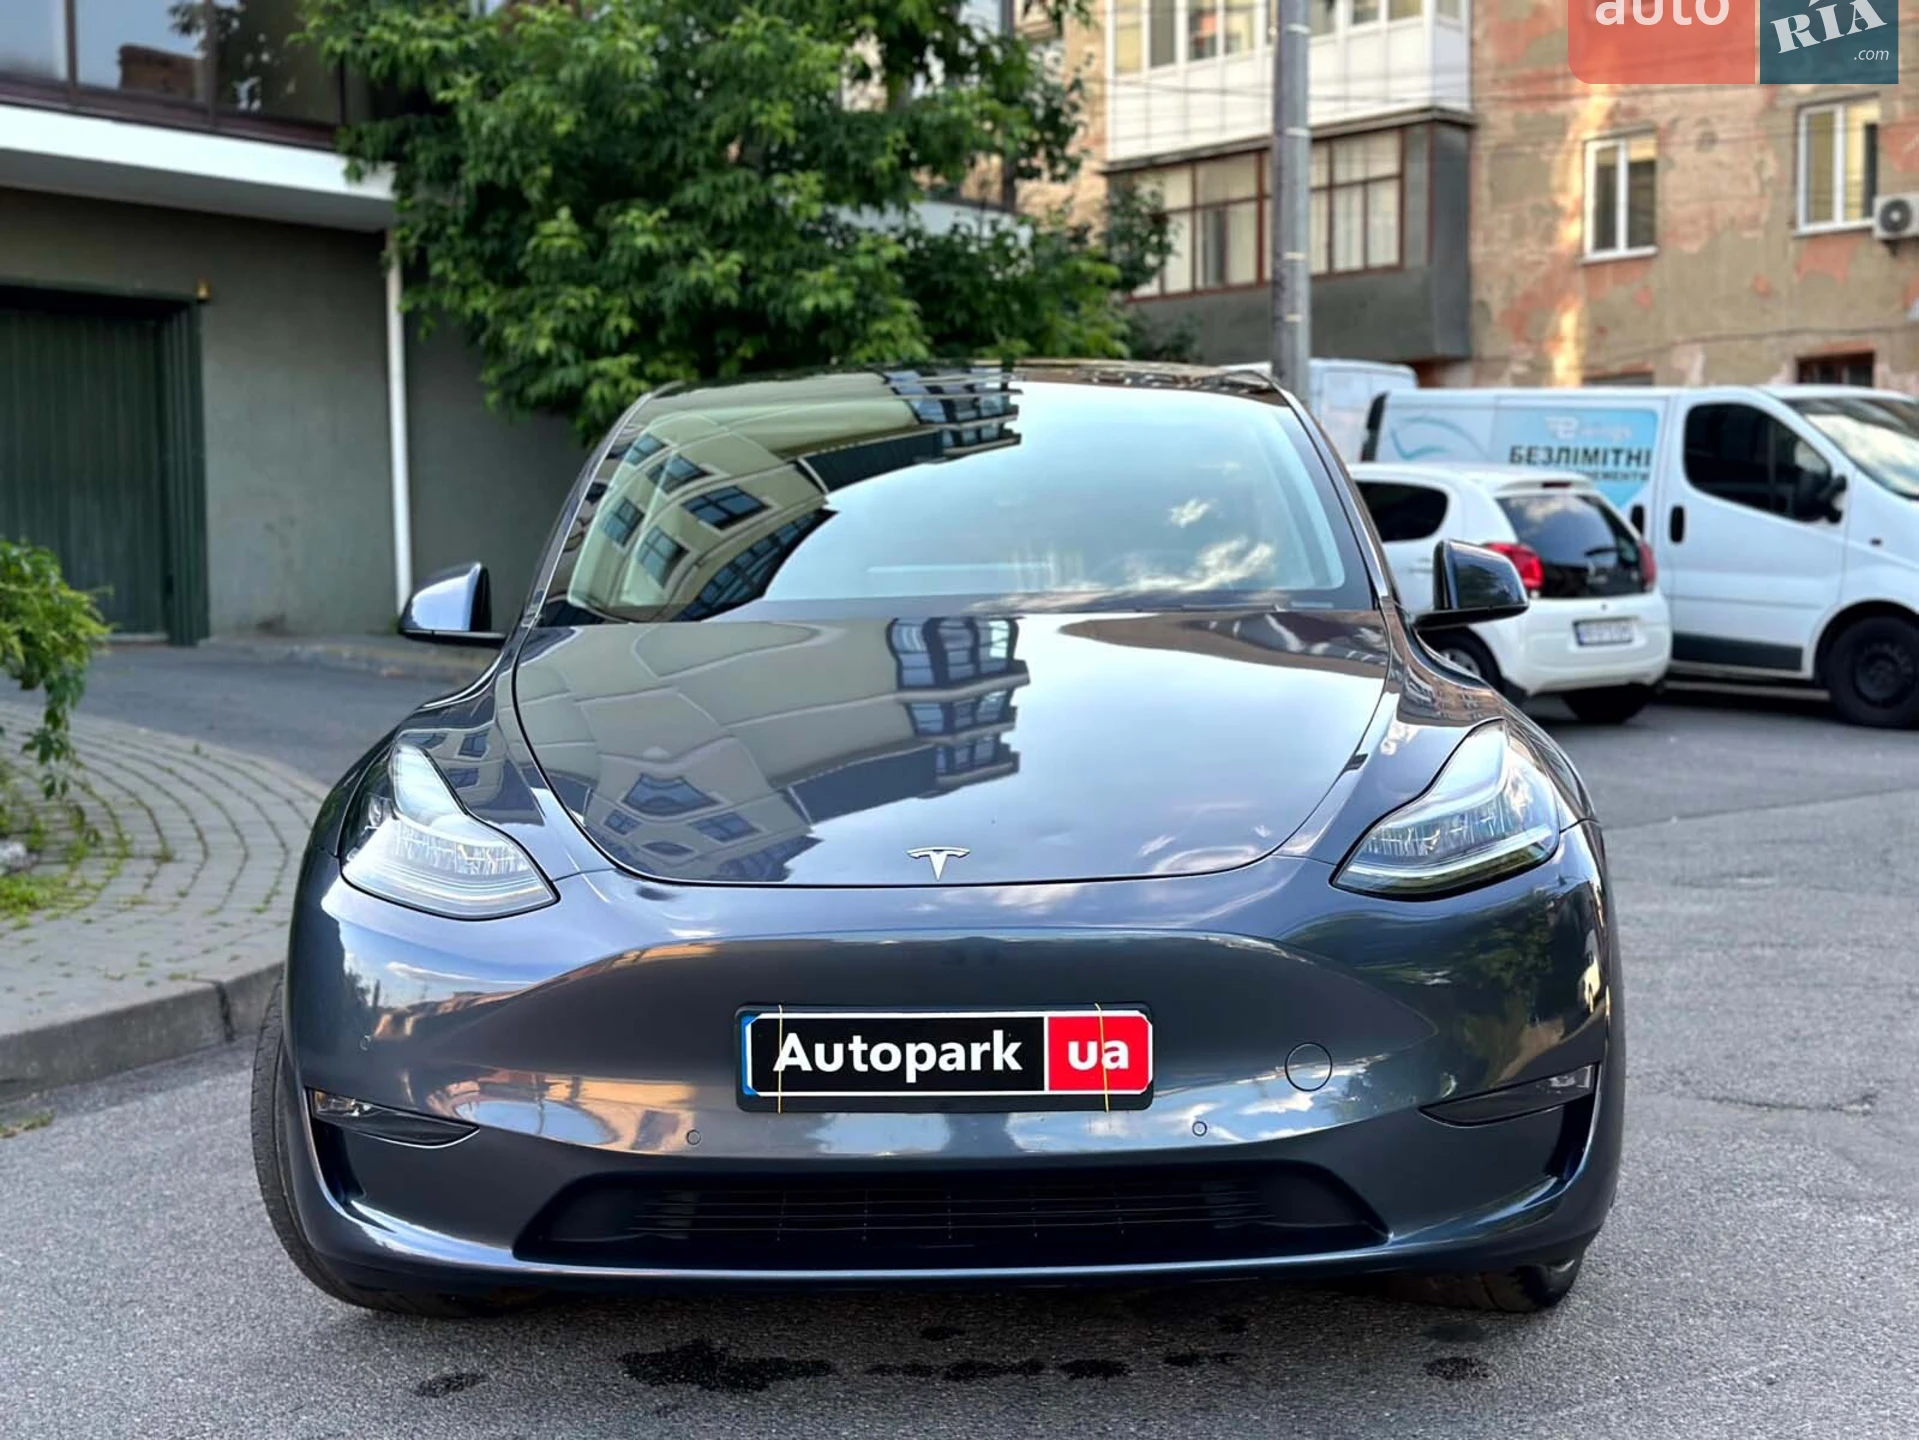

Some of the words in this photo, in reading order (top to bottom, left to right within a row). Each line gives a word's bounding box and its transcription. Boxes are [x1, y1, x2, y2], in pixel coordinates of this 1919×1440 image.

[1509, 445, 1652, 467] БЕЗЛІМІТНІ
[772, 1029, 1023, 1084] Autopark
[1067, 1039, 1130, 1071] ua
